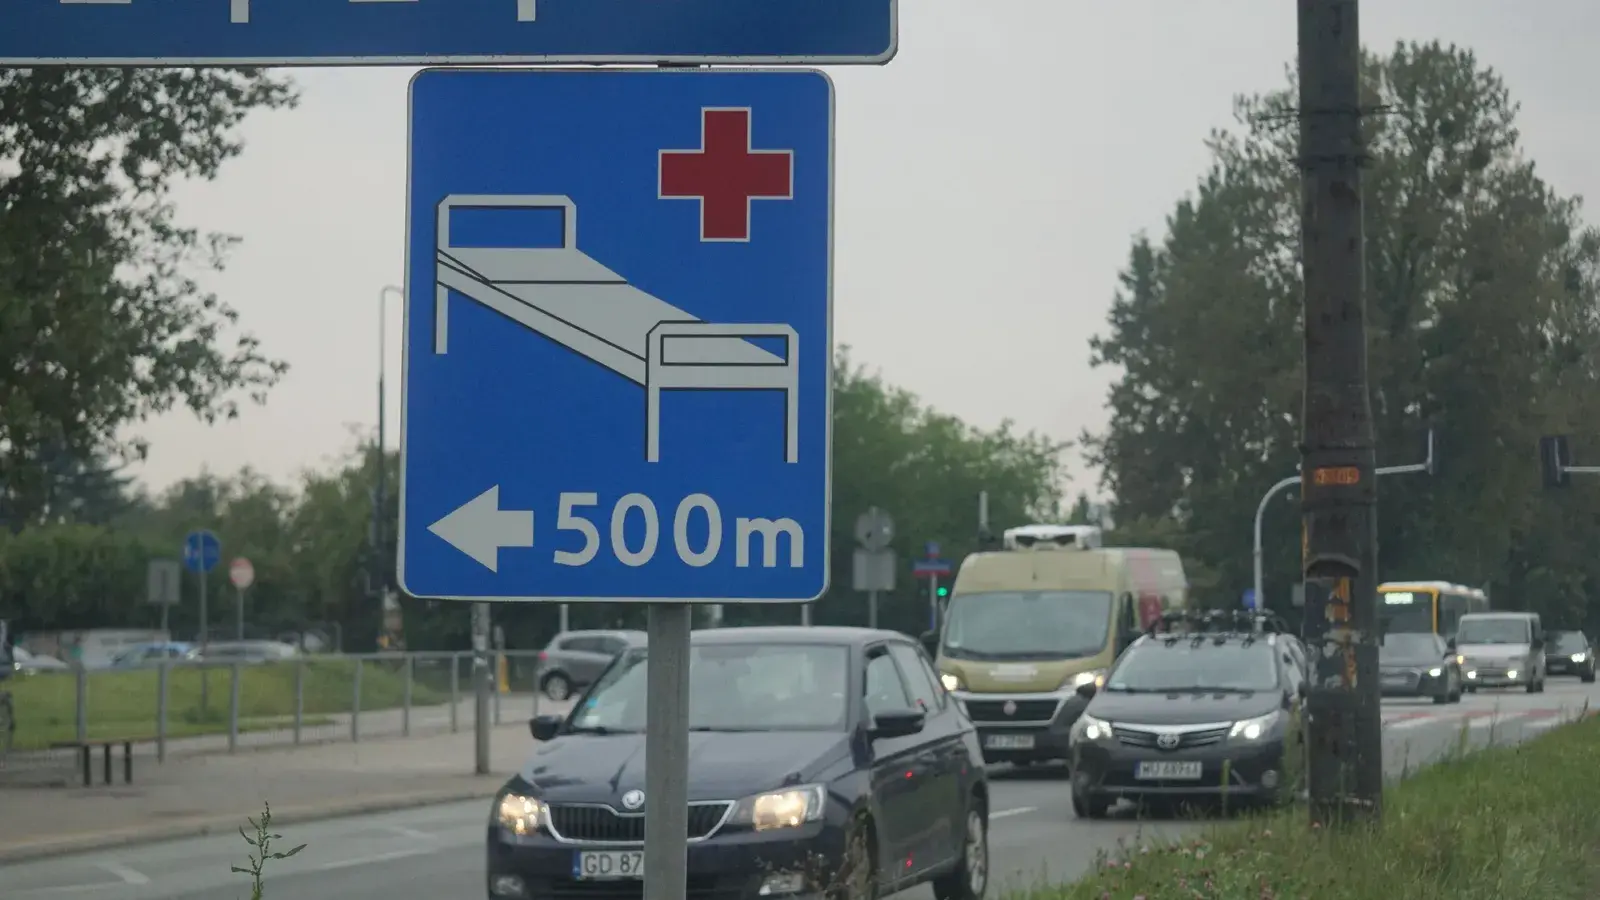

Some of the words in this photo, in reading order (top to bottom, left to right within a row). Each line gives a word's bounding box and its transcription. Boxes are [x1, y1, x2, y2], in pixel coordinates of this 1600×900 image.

[553, 492, 804, 567] 500m
[585, 854, 612, 873] GD
[620, 853, 642, 873] 87
